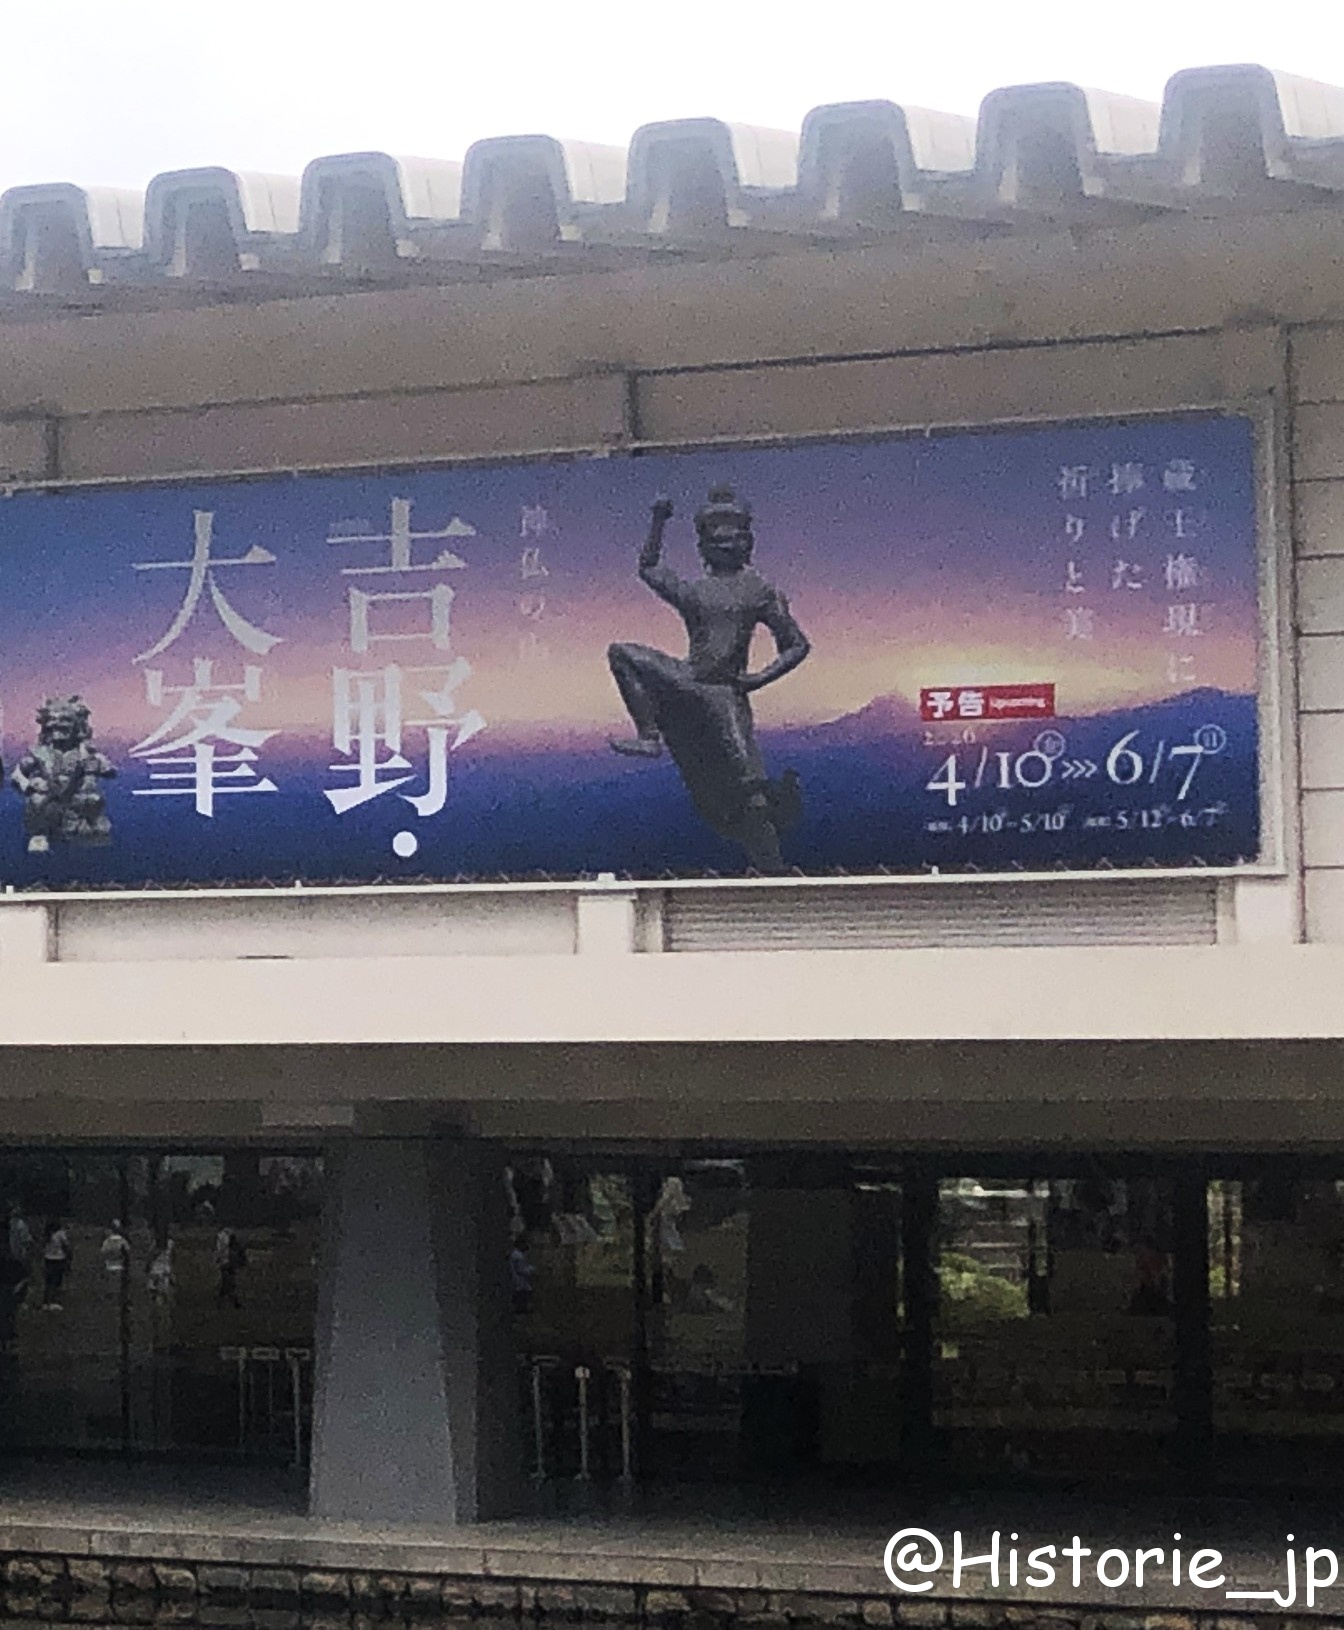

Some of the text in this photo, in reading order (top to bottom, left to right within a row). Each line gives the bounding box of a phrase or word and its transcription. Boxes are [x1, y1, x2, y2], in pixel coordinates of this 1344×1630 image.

[128, 510, 285, 818] 大峯
[926, 690, 985, 718] 予告
[925, 746, 1052, 806] 4/10
[1106, 730, 1204, 800] 6/7
